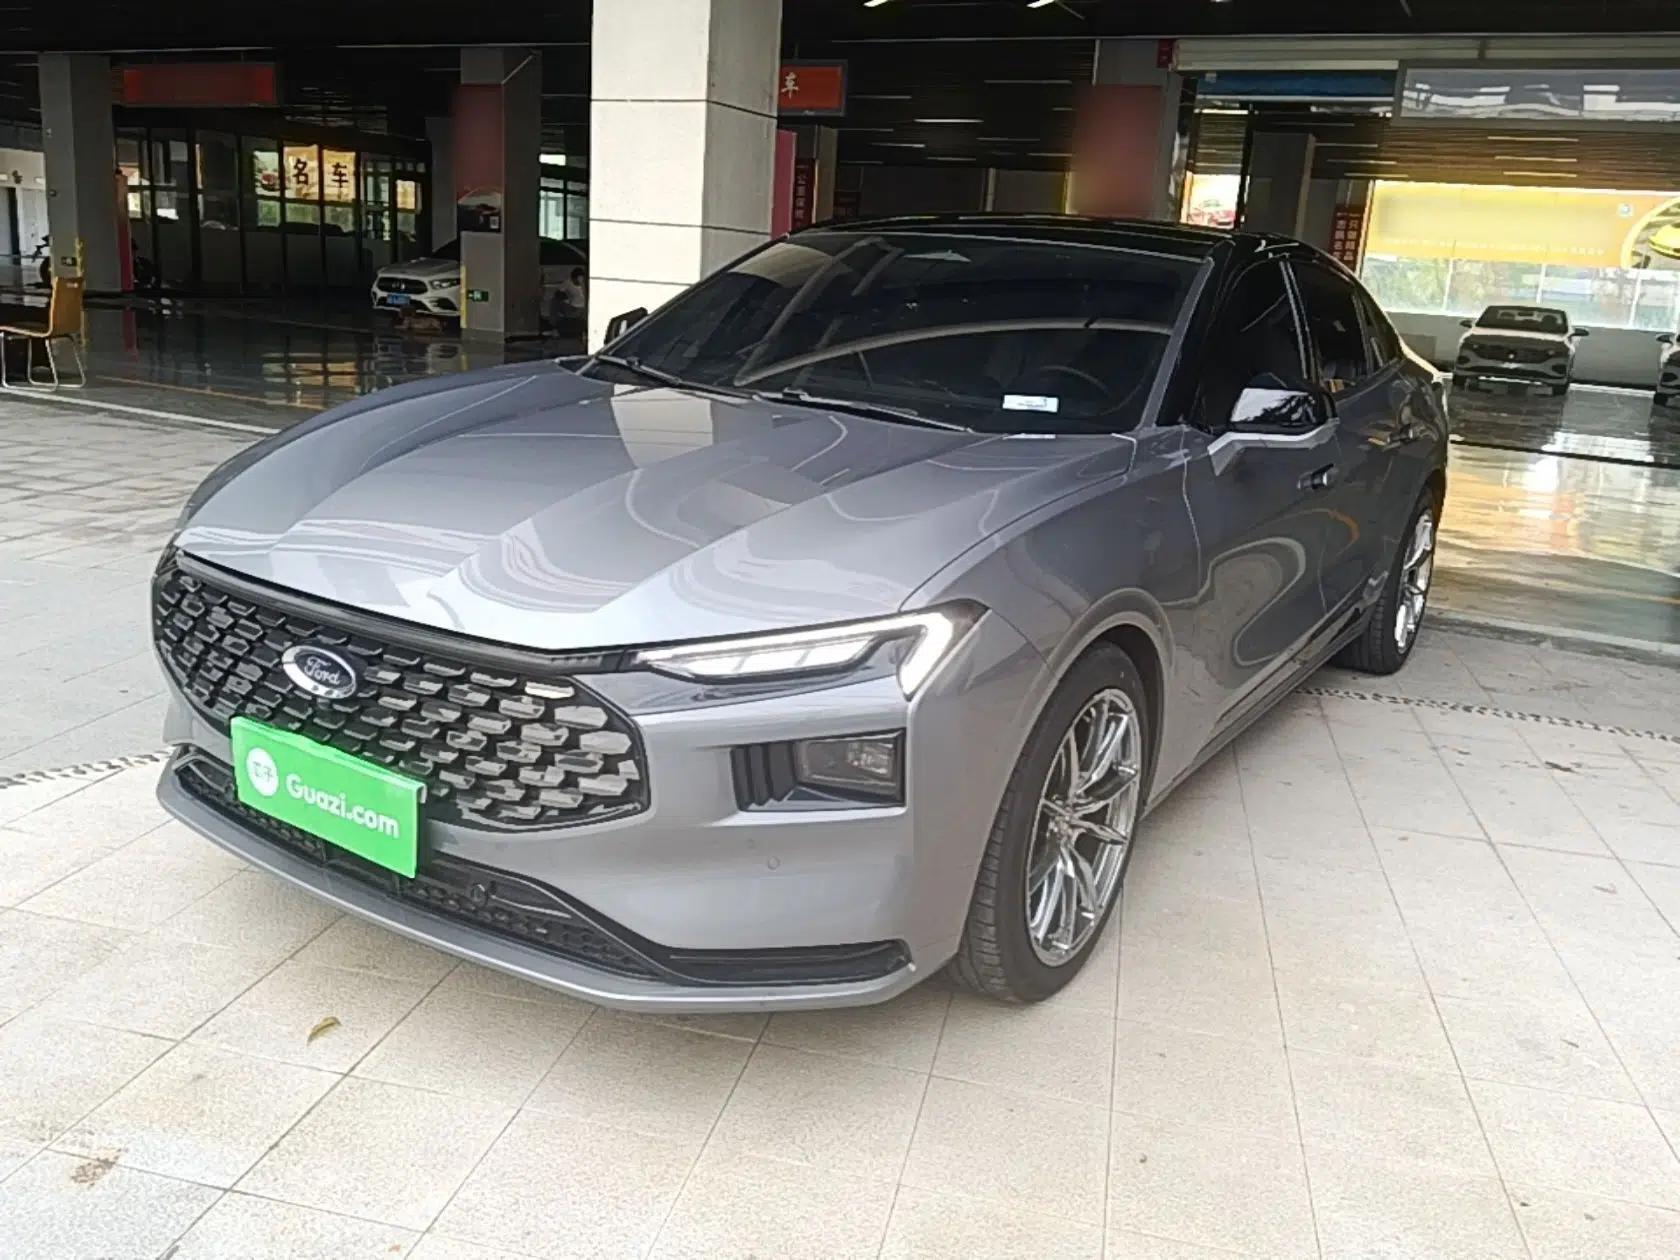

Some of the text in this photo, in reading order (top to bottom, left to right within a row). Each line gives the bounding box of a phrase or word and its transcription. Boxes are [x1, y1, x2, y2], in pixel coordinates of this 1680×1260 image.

[293, 158, 349, 189] 名车
[304, 656, 341, 685] Ford
[285, 773, 400, 839] Guazi.com
